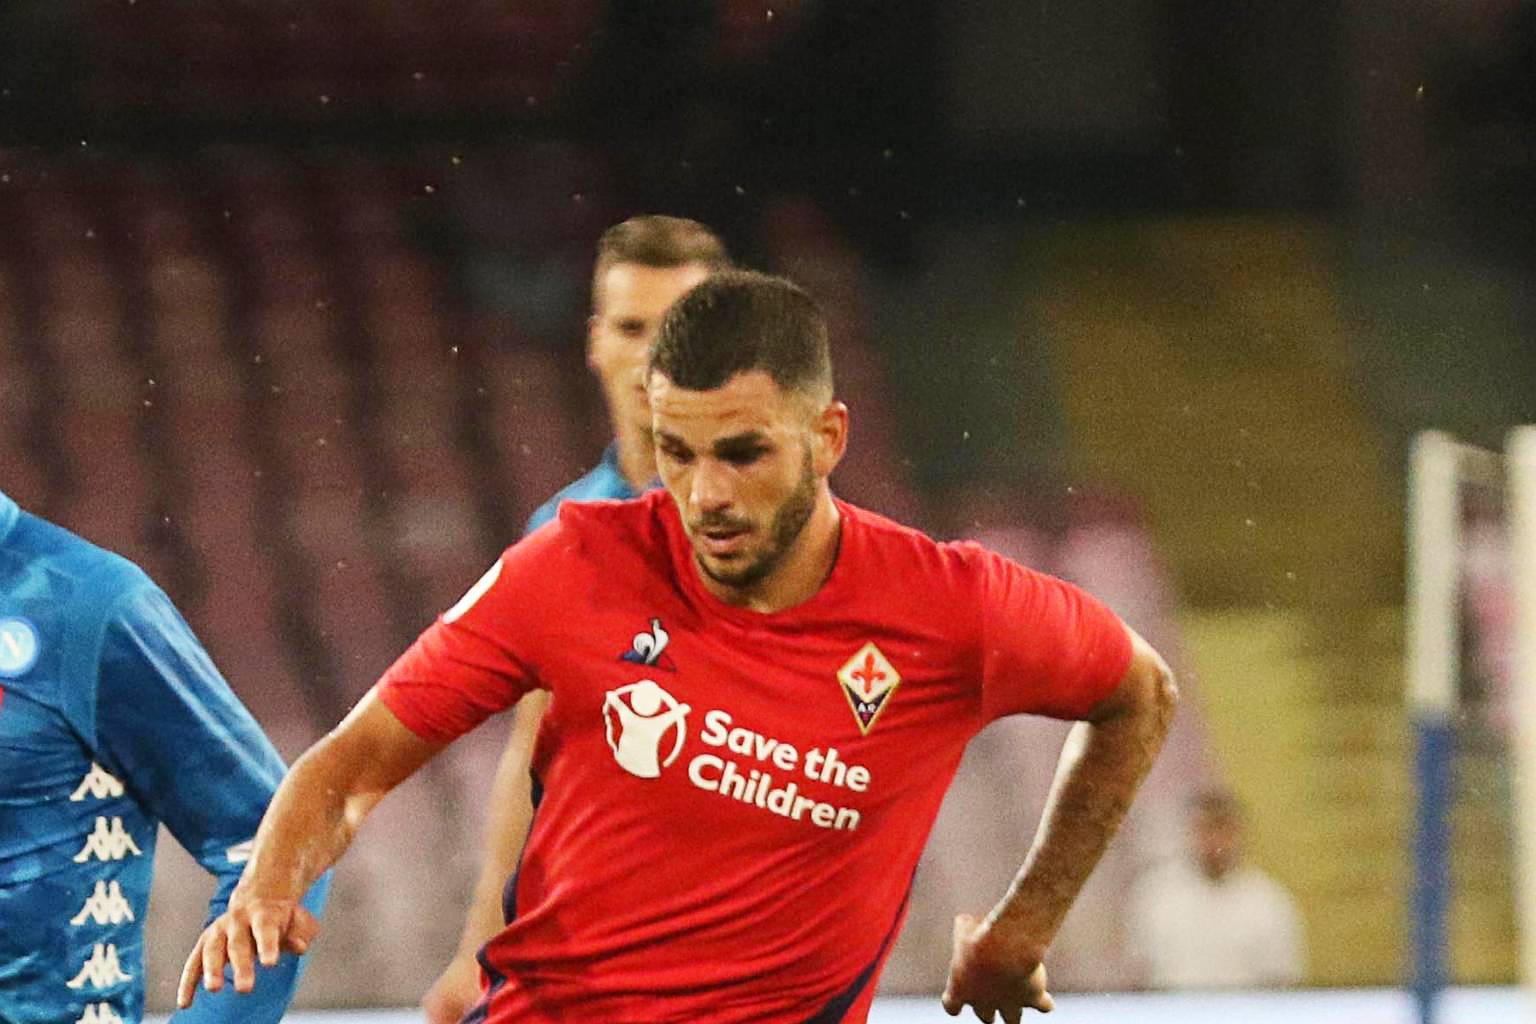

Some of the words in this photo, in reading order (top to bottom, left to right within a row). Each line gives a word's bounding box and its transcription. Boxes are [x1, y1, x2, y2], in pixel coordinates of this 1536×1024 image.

[700, 709, 799, 772] Save
[804, 747, 871, 792] the
[688, 753, 861, 832] Children
